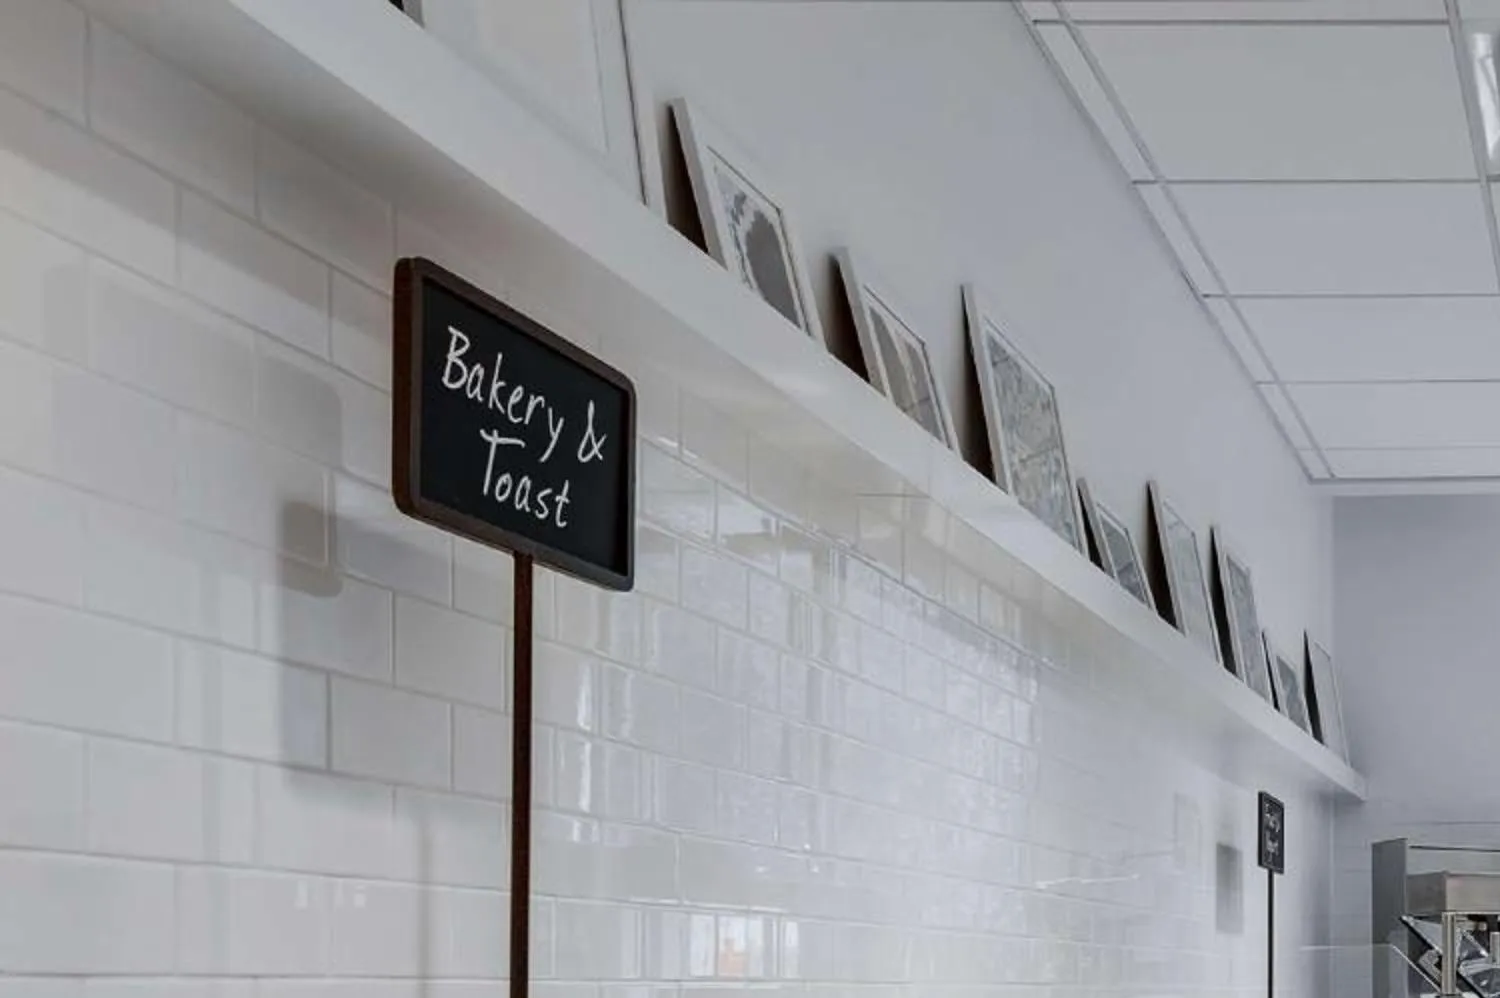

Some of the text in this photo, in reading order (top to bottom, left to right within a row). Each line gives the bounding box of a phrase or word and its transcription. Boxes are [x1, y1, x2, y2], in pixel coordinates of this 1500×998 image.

[441, 325, 607, 463] Bakery &
[480, 429, 572, 528] Toast
